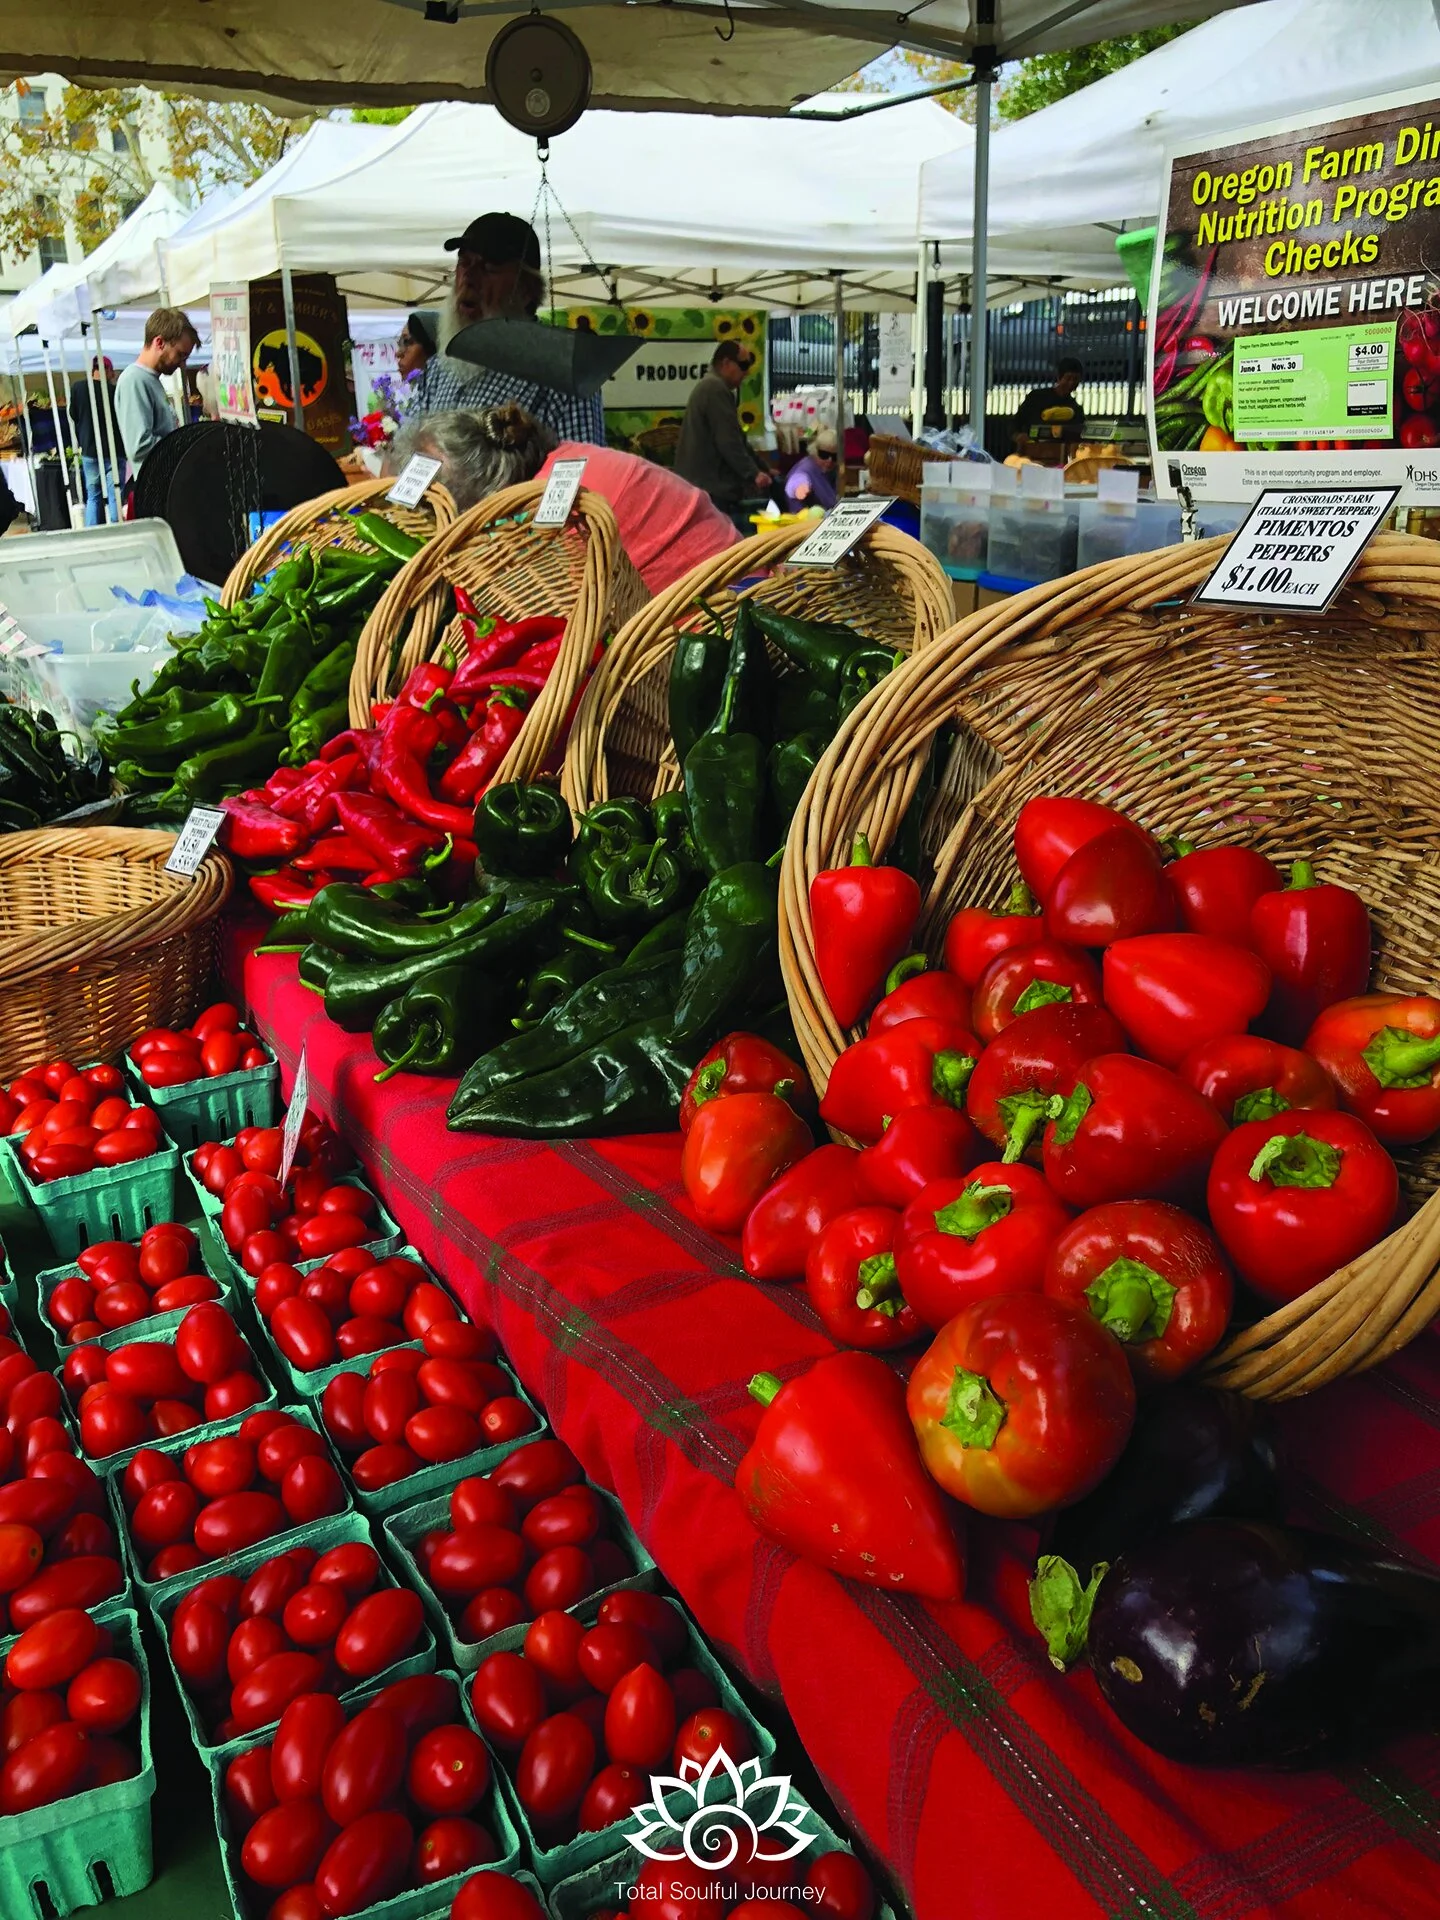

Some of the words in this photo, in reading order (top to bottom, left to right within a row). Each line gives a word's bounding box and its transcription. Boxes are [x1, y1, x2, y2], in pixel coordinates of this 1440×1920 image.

[1192, 160, 1293, 206] Oregon
[1303, 141, 1384, 184] Farm
[1197, 197, 1323, 246] Nutrition
[1264, 230, 1379, 277] Checks
[1218, 286, 1342, 327] WELCOME
[1348, 275, 1426, 313] HERE
[1355, 344, 1383, 357] $4.00
[1287, 362, 1296, 370] 30
[1182, 464, 1206, 476] Oregon
[1269, 469, 1283, 478] equal
[1284, 468, 1315, 478] opportunity
[1354, 469, 1382, 478] employer.
[1414, 470, 1438, 482] DHS
[1282, 494, 1344, 504] CROSSROADS
[1344, 494, 1374, 504] FARM
[1257, 506, 1298, 516] (ITALIAN
[1300, 506, 1335, 516] SWEET
[1332, 506, 1380, 516] PEPPER!)
[828, 516, 868, 527] POBLANO
[817, 530, 854, 540] PEPPERS
[1254, 520, 1360, 538] PIMENTOS
[1246, 544, 1335, 562] PEPPERS
[1222, 564, 1293, 593] $1.00
[1282, 582, 1320, 595] EACH
